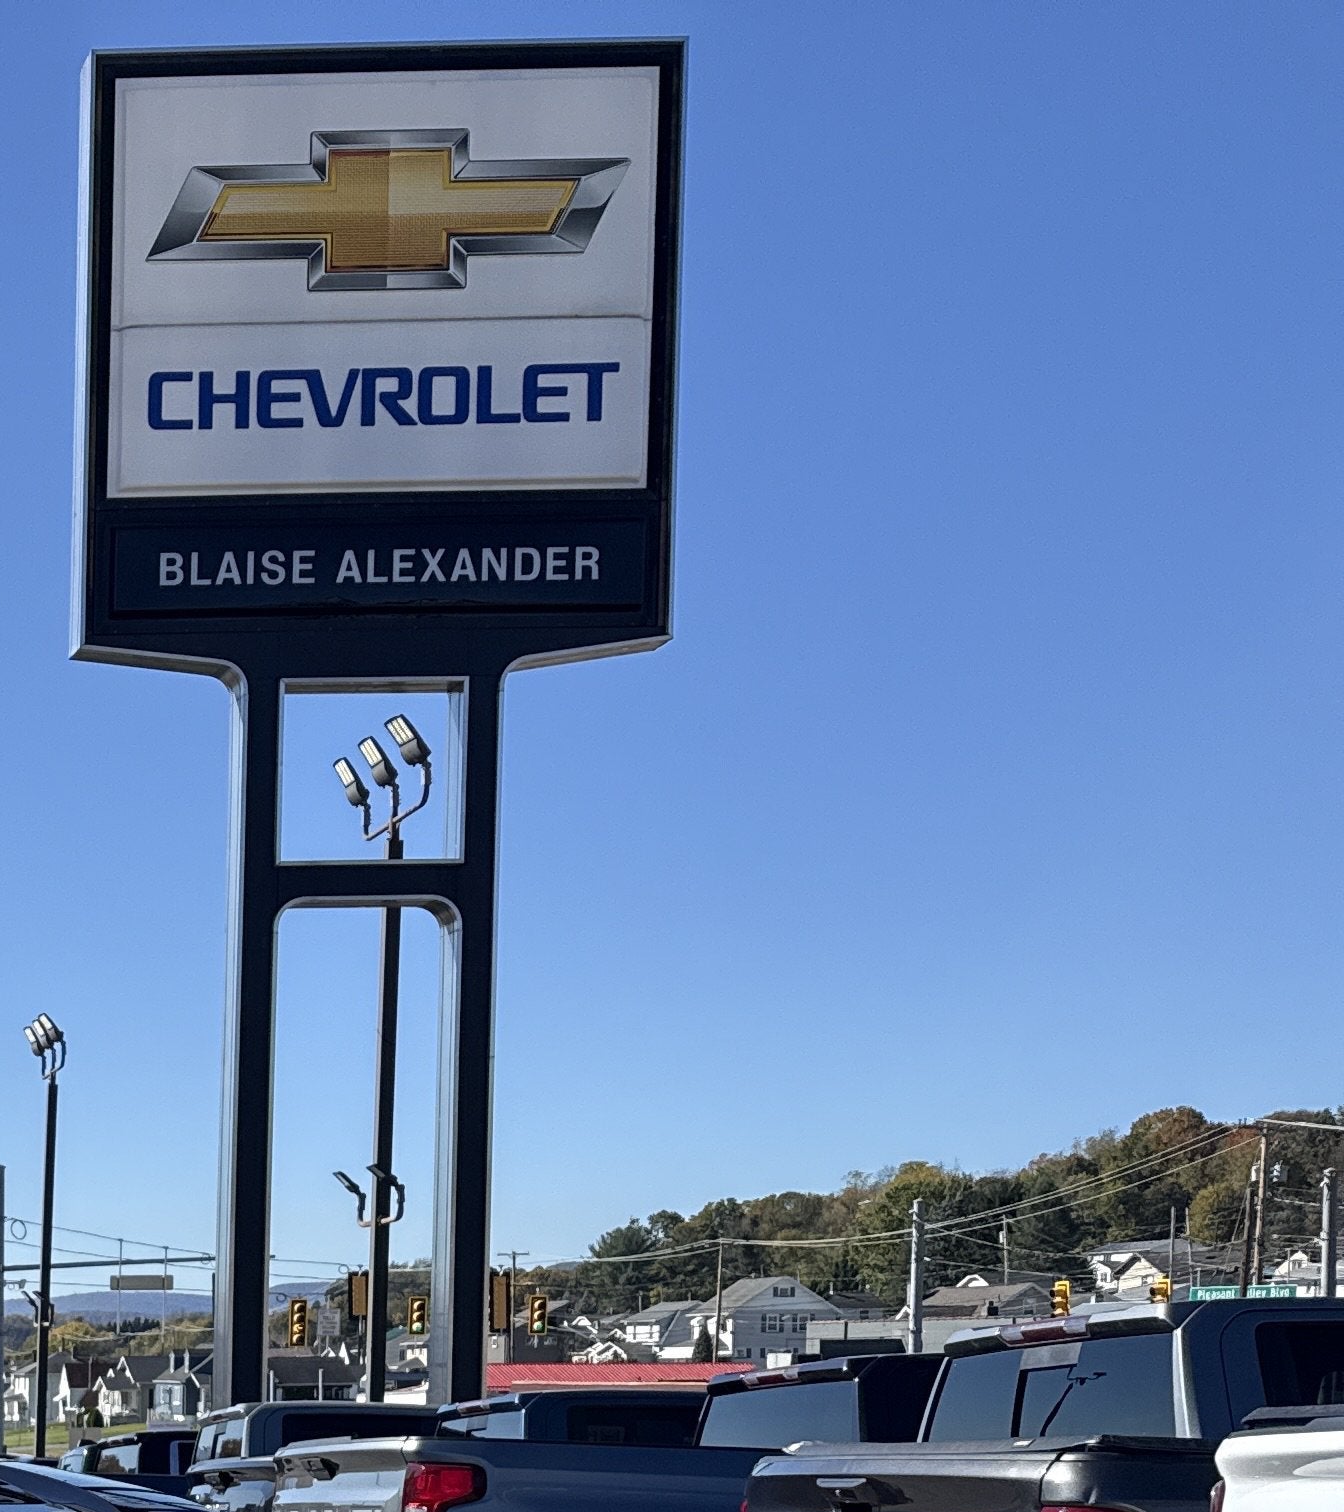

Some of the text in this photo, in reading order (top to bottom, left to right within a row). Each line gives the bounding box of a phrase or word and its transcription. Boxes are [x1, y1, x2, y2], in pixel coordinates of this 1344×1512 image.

[148, 362, 620, 430] CHEVROLET
[159, 546, 601, 587] BLAISE ALEXANDER
[1197, 1288, 1236, 1301] Pleasant
[1269, 1286, 1290, 1298] Blvd
